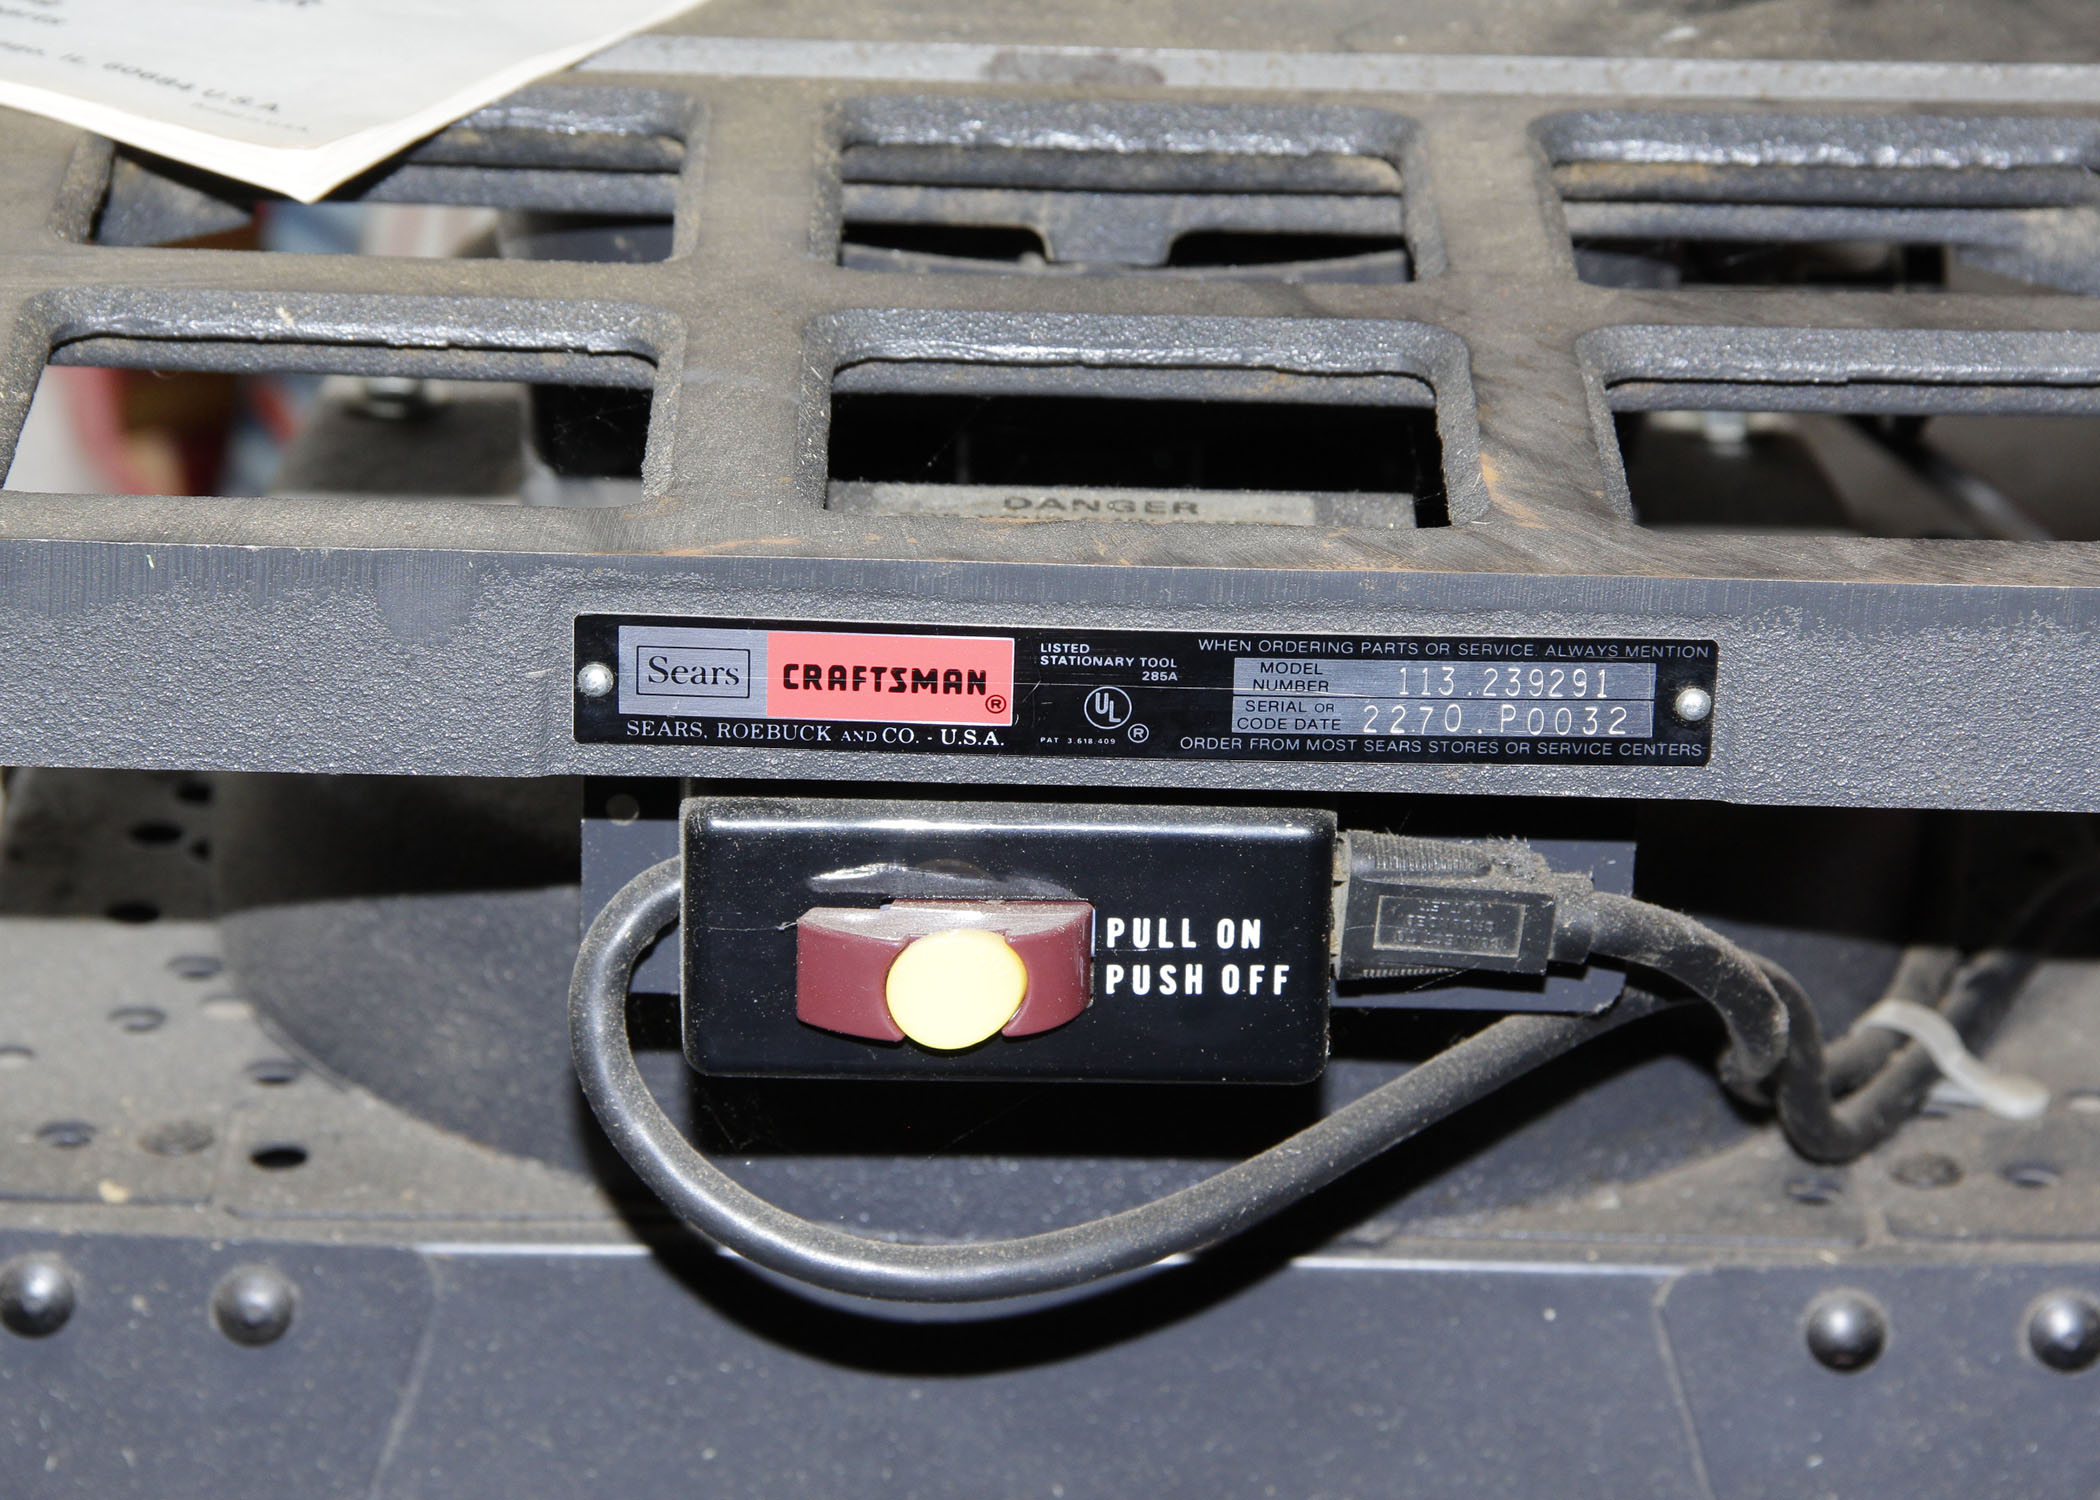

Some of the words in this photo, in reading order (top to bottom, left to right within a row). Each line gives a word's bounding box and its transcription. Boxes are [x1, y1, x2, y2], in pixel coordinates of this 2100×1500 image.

[1003, 496, 1200, 515] DANGER
[1040, 642, 1090, 654] LISTED
[1198, 639, 1252, 652] WHEN
[1258, 639, 1354, 654] ORDERING
[1361, 641, 1419, 655] PARTS
[1425, 642, 1450, 656] OR
[1544, 644, 1620, 658] ALWAYS
[1622, 645, 1709, 659] MENTION
[648, 655, 740, 686] Sears
[1040, 655, 1135, 667] STATIONARY
[1139, 657, 1177, 668] TOOL
[1260, 661, 1324, 676] MODEL
[783, 663, 987, 696] CRAFTSMAN
[1141, 670, 1178, 682] 285A
[1252, 678, 1329, 693] NUMBER
[1399, 667, 1608, 698] 113.239291
[1245, 699, 1308, 713] SERIAL
[1314, 702, 1335, 714] OR
[626, 719, 708, 738] SEARS,
[717, 719, 835, 742] ROEBUCK
[840, 730, 877, 742] AND
[882, 727, 919, 744] CO.
[940, 728, 1004, 746] U.S.A.
[1236, 717, 1288, 730] CODE
[1294, 718, 1342, 731] DATE
[1180, 736, 1242, 750] ORDER
[1249, 737, 1300, 751] FROM
[1306, 738, 1358, 752] MOST
[1363, 739, 1422, 753] SEARS
[1428, 740, 1499, 754] STORES
[1505, 741, 1530, 754] OR
[1536, 741, 1613, 756] SERVICE
[1619, 742, 1702, 757] CENTERS
[1105, 916, 1198, 950] PULL
[1216, 918, 1261, 950] ON
[1105, 963, 1203, 996] PUSH
[1221, 963, 1290, 996] OFF
